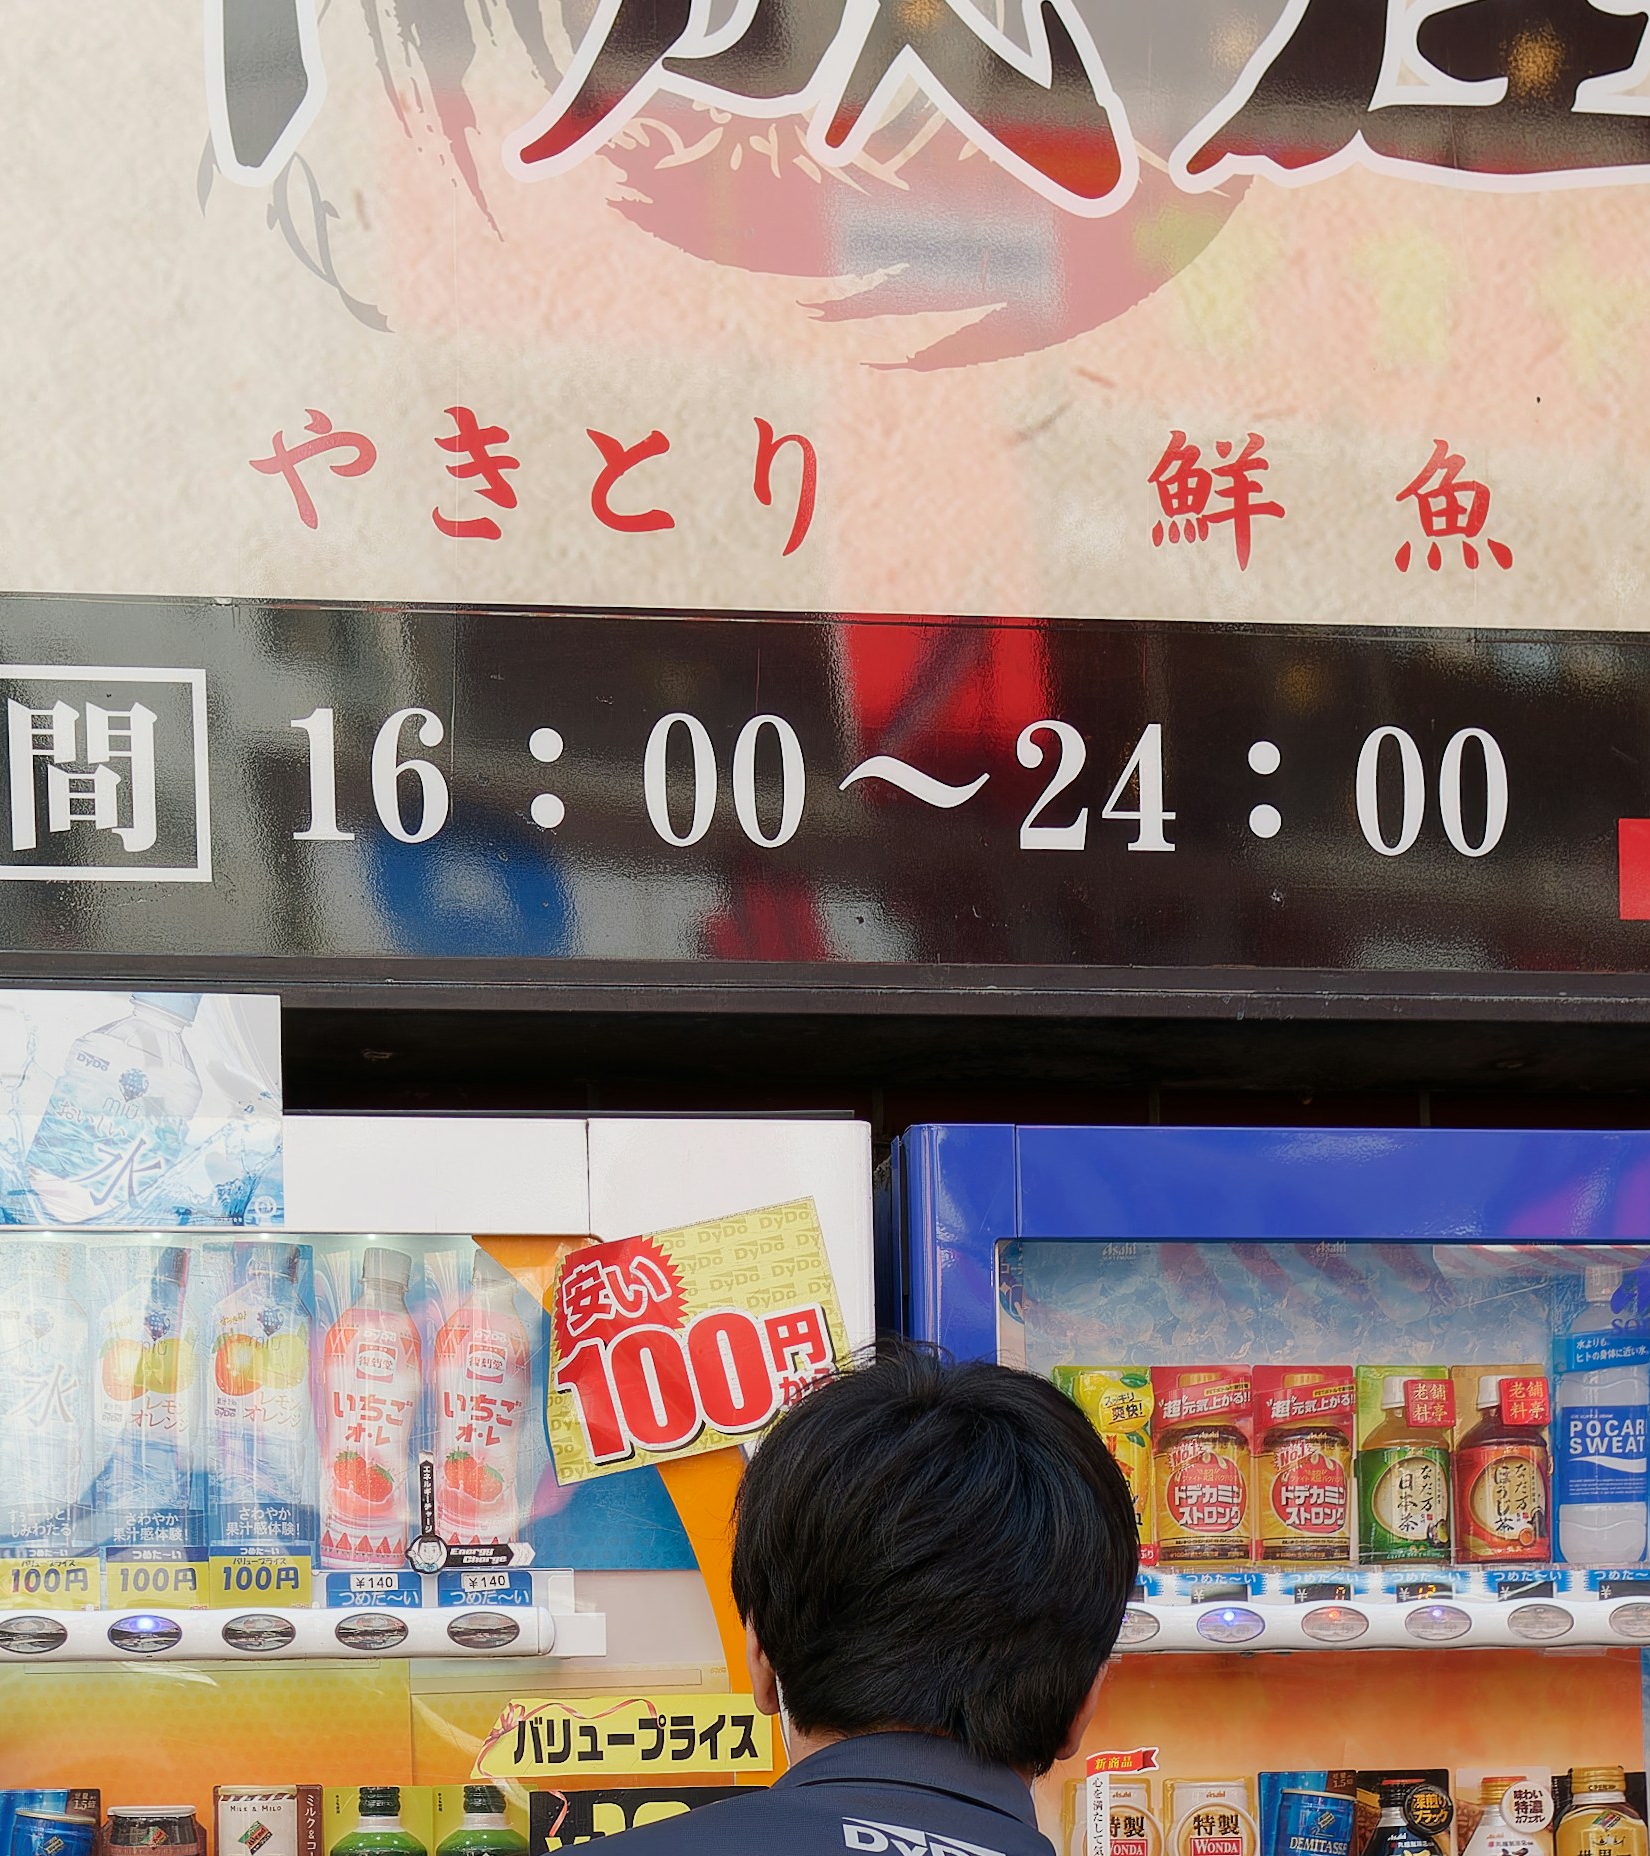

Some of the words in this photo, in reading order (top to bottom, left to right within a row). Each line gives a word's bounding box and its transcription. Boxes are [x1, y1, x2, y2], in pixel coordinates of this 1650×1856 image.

[249, 406, 819, 557] やきとり
[1146, 427, 1516, 574] 鮮魚
[560, 1255, 673, 1333] 安い
[1413, 1382, 1448, 1400] 老舗
[333, 1391, 405, 1428] いちご
[1414, 1402, 1447, 1423] 料亭
[1569, 1436, 1646, 1454] SWEAT
[1174, 1484, 1244, 1505] ドデカミン
[238, 1506, 292, 1521] さわやか
[1179, 1506, 1242, 1526] ストロング
[226, 1520, 301, 1537] 果汁感体験!
[223, 1566, 301, 1592] 100円
[355, 1574, 394, 1588] ¥140
[513, 1712, 759, 1765] バリュープライス
[1094, 1755, 1134, 1771] 新商品
[1193, 1814, 1239, 1835] 特製
[1193, 1840, 1240, 1855] WONDA
